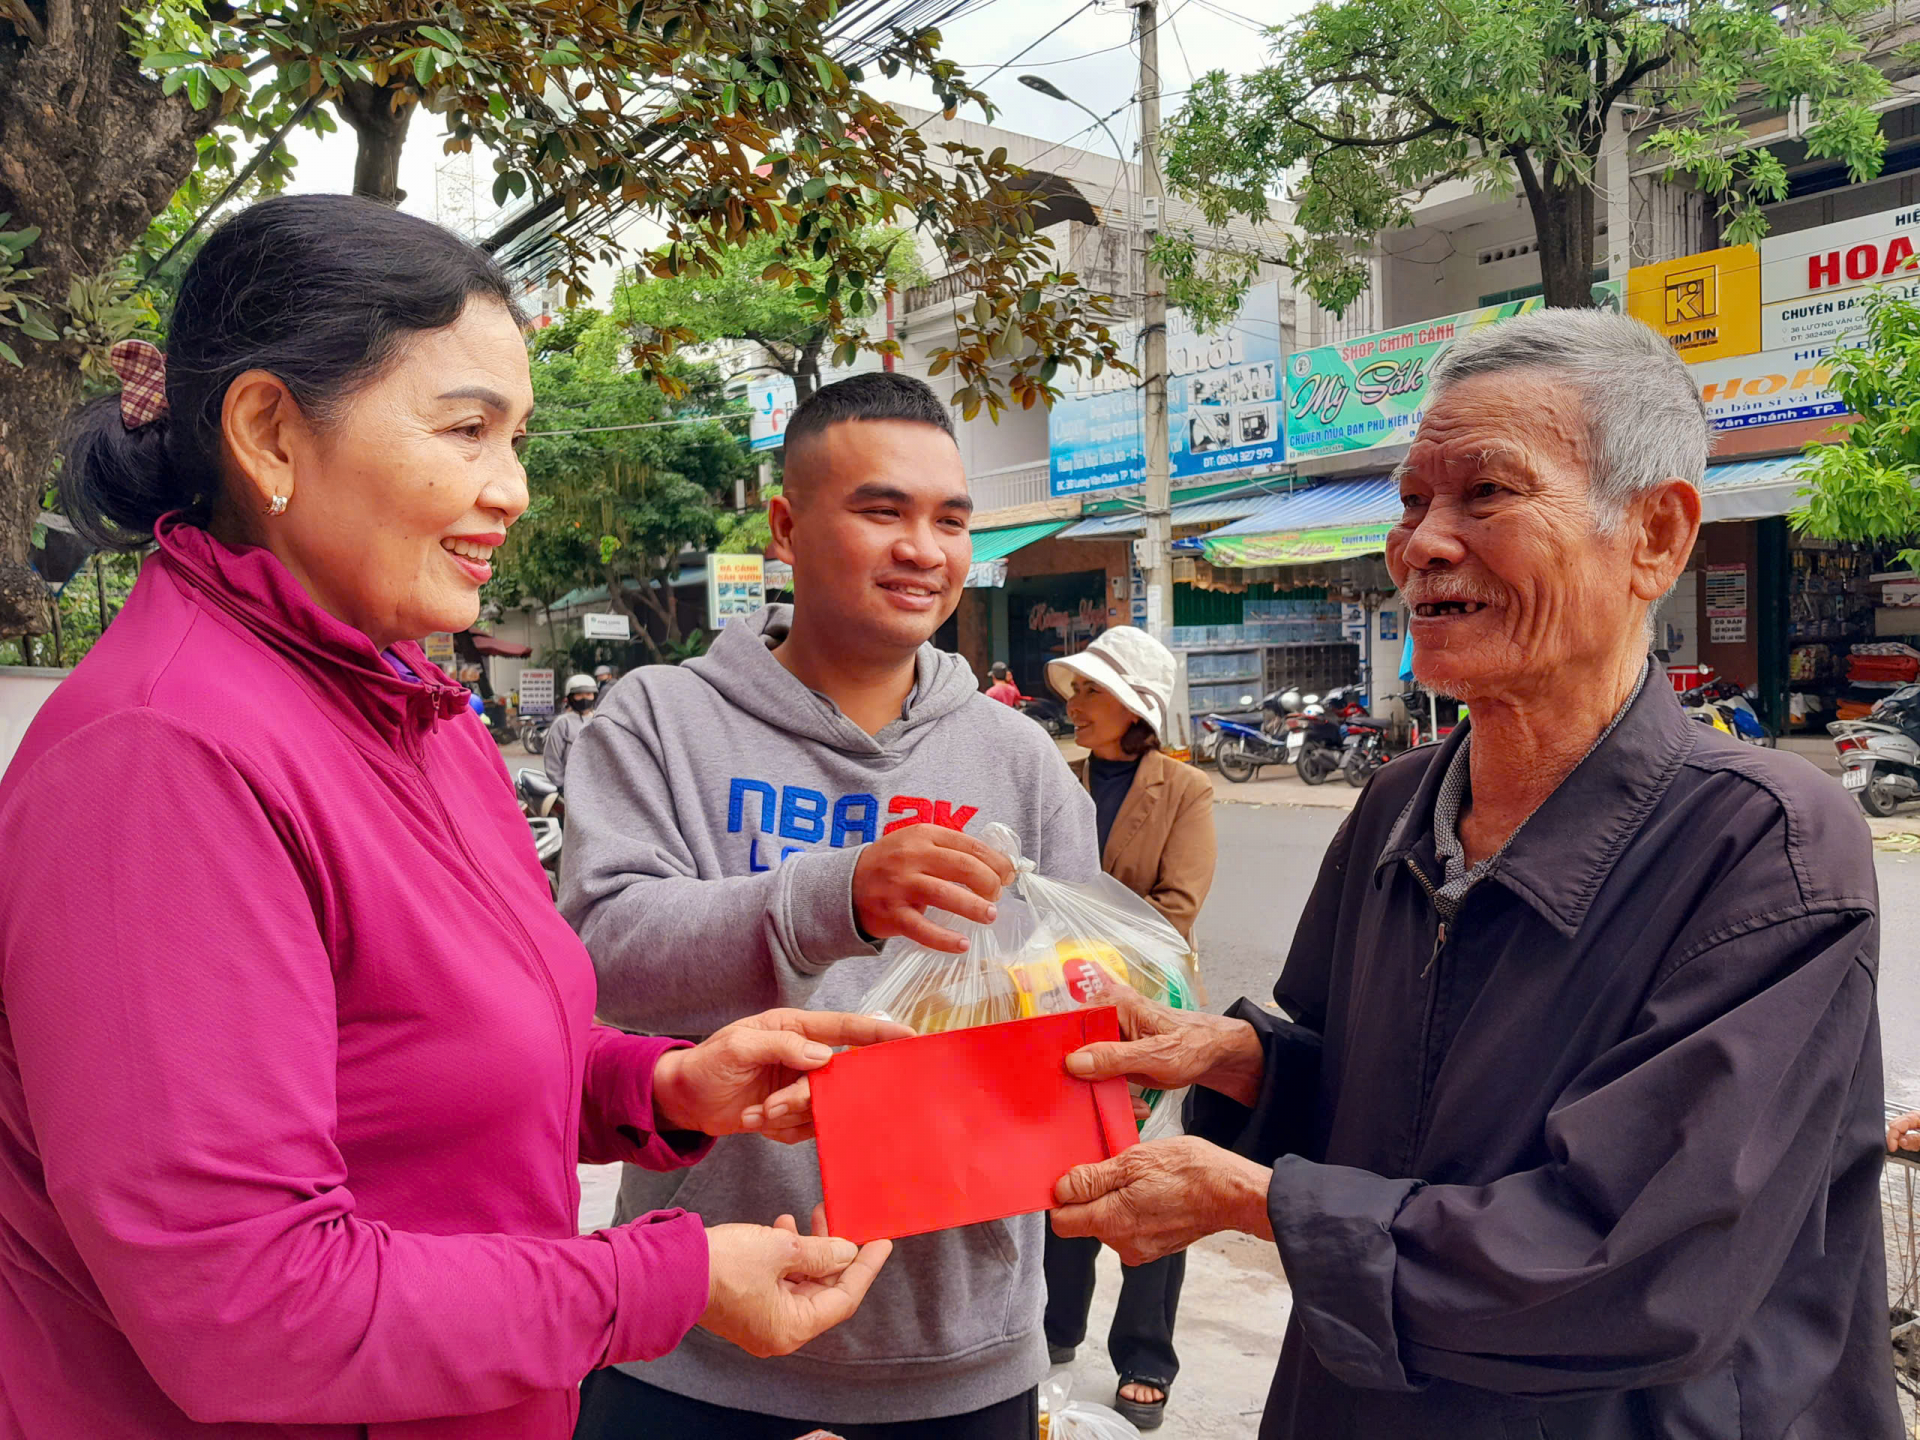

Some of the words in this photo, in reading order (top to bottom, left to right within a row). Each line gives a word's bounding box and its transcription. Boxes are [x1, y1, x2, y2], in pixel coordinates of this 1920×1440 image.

[1808, 236, 1919, 290] HOA
[1781, 303, 1833, 321] CHUYÊN
[1838, 297, 1866, 311] BÁ
[1342, 342, 1375, 362] SHOP
[1379, 332, 1414, 354] CHIM
[1418, 323, 1455, 345] CẢNH
[1693, 328, 1717, 340] TIN
[1701, 365, 1833, 403] HOA
[1731, 401, 1762, 413] bán
[1789, 393, 1808, 403] và
[1748, 409, 1797, 424] chánh
[1813, 404, 1837, 415] TP.
[727, 777, 879, 848] NBA
